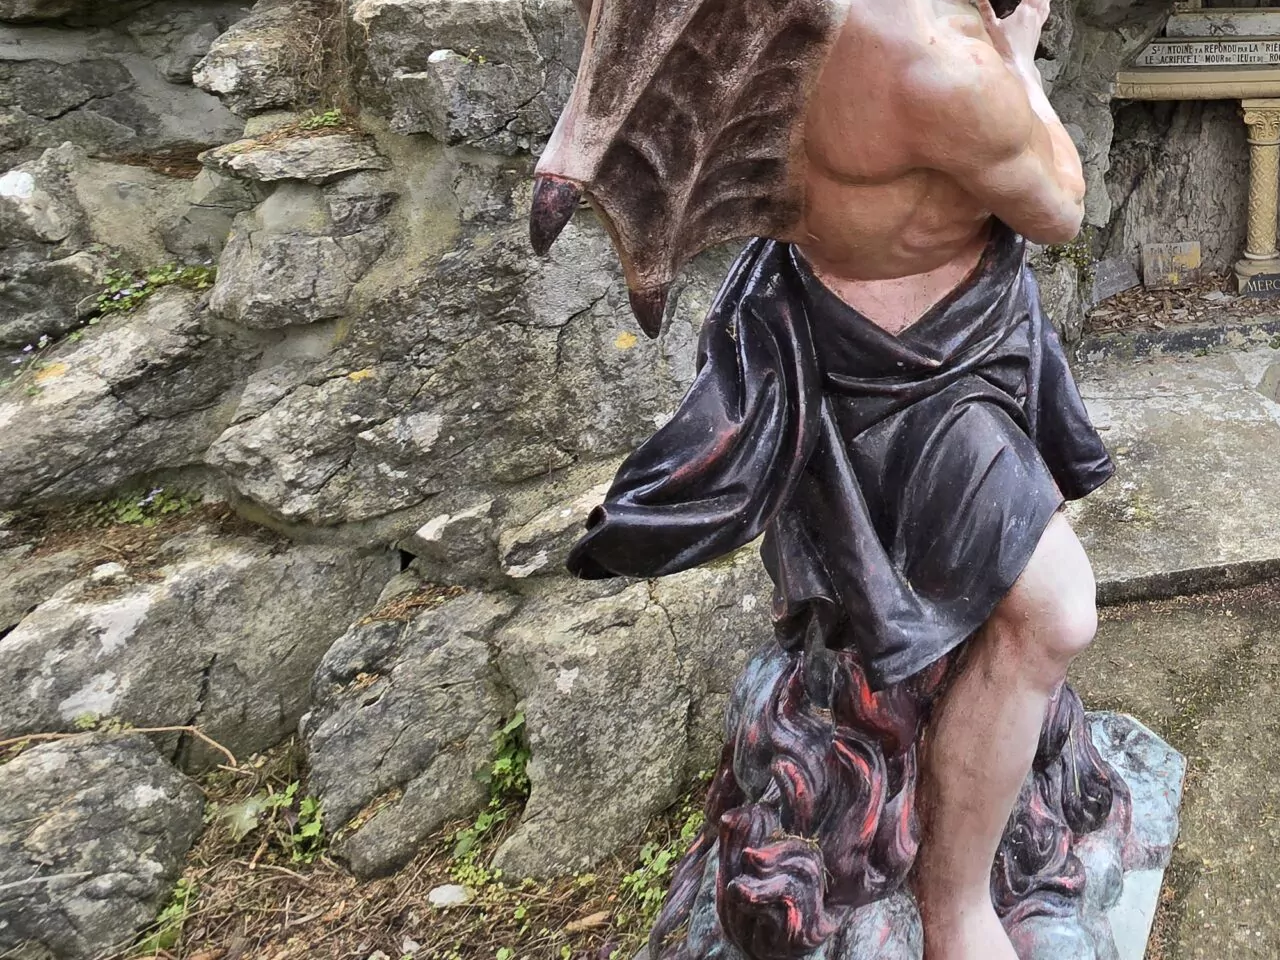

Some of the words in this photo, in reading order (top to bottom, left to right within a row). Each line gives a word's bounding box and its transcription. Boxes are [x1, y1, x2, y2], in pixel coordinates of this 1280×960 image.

[1250, 44, 1258, 52] LA
[1145, 55, 1153, 64] LE
[1194, 54, 1224, 63] L'MOUR
